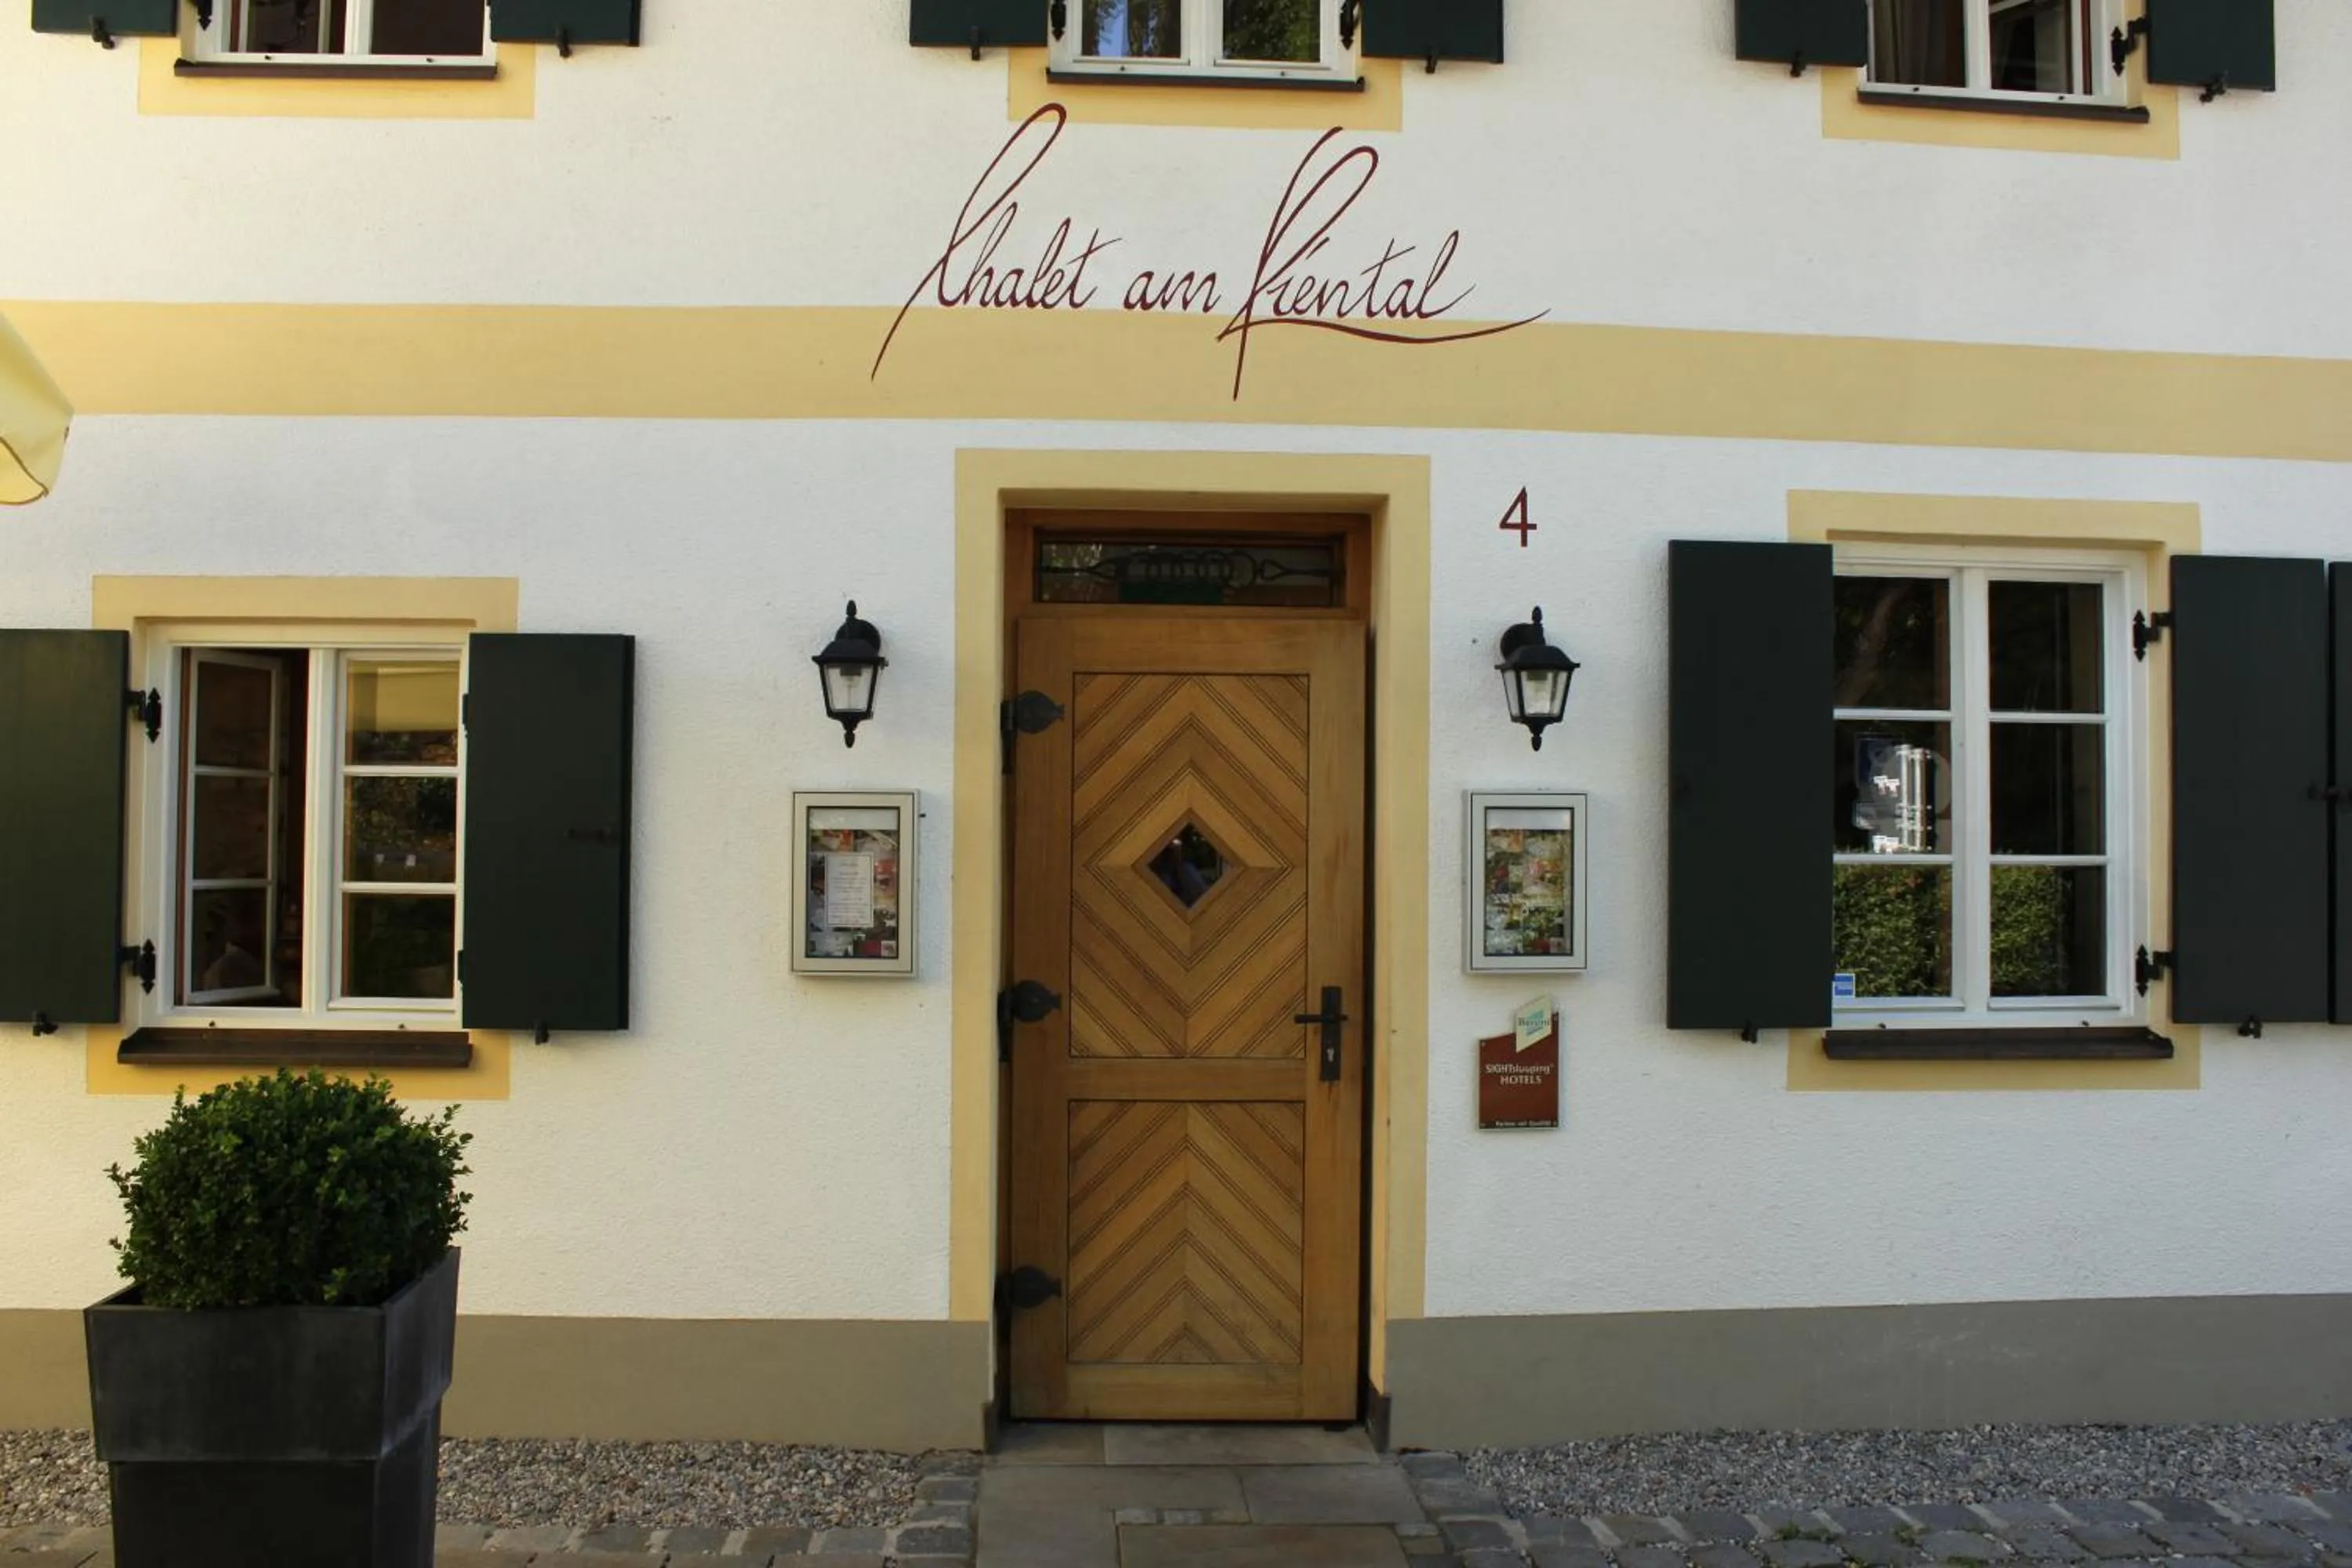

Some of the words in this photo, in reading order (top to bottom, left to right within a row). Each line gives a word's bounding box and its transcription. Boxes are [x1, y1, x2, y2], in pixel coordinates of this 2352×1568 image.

[1123, 270, 1221, 314] am
[1499, 485, 1537, 547] 4
[1500, 1074, 1543, 1086] HOTELS
